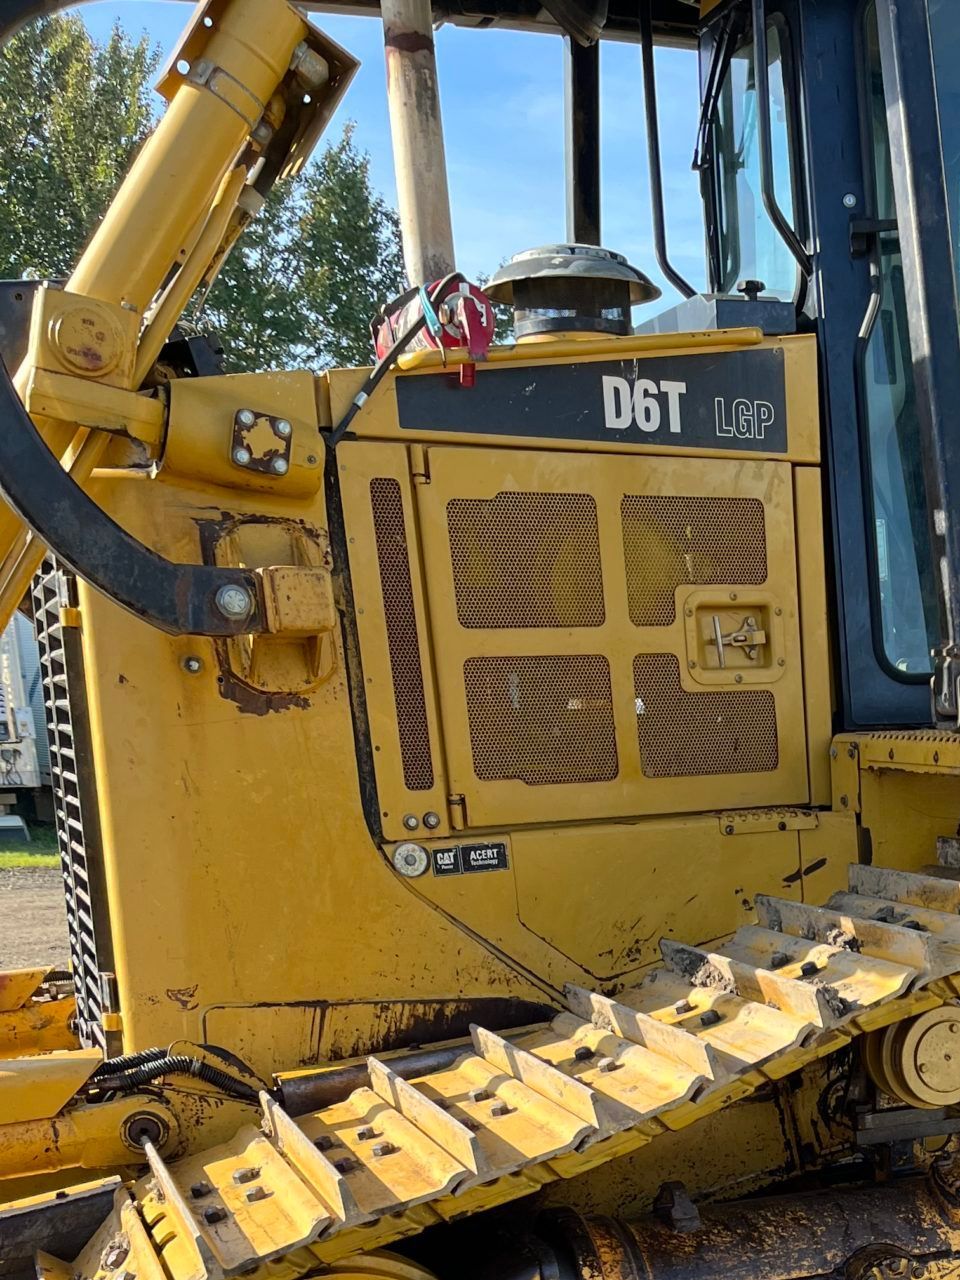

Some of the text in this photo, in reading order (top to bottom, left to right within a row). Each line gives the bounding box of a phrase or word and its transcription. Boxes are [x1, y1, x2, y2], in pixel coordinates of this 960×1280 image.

[602, 375, 774, 439] D6T LGP
[437, 852, 454, 864] CAT
[470, 849, 498, 860] ACERT
